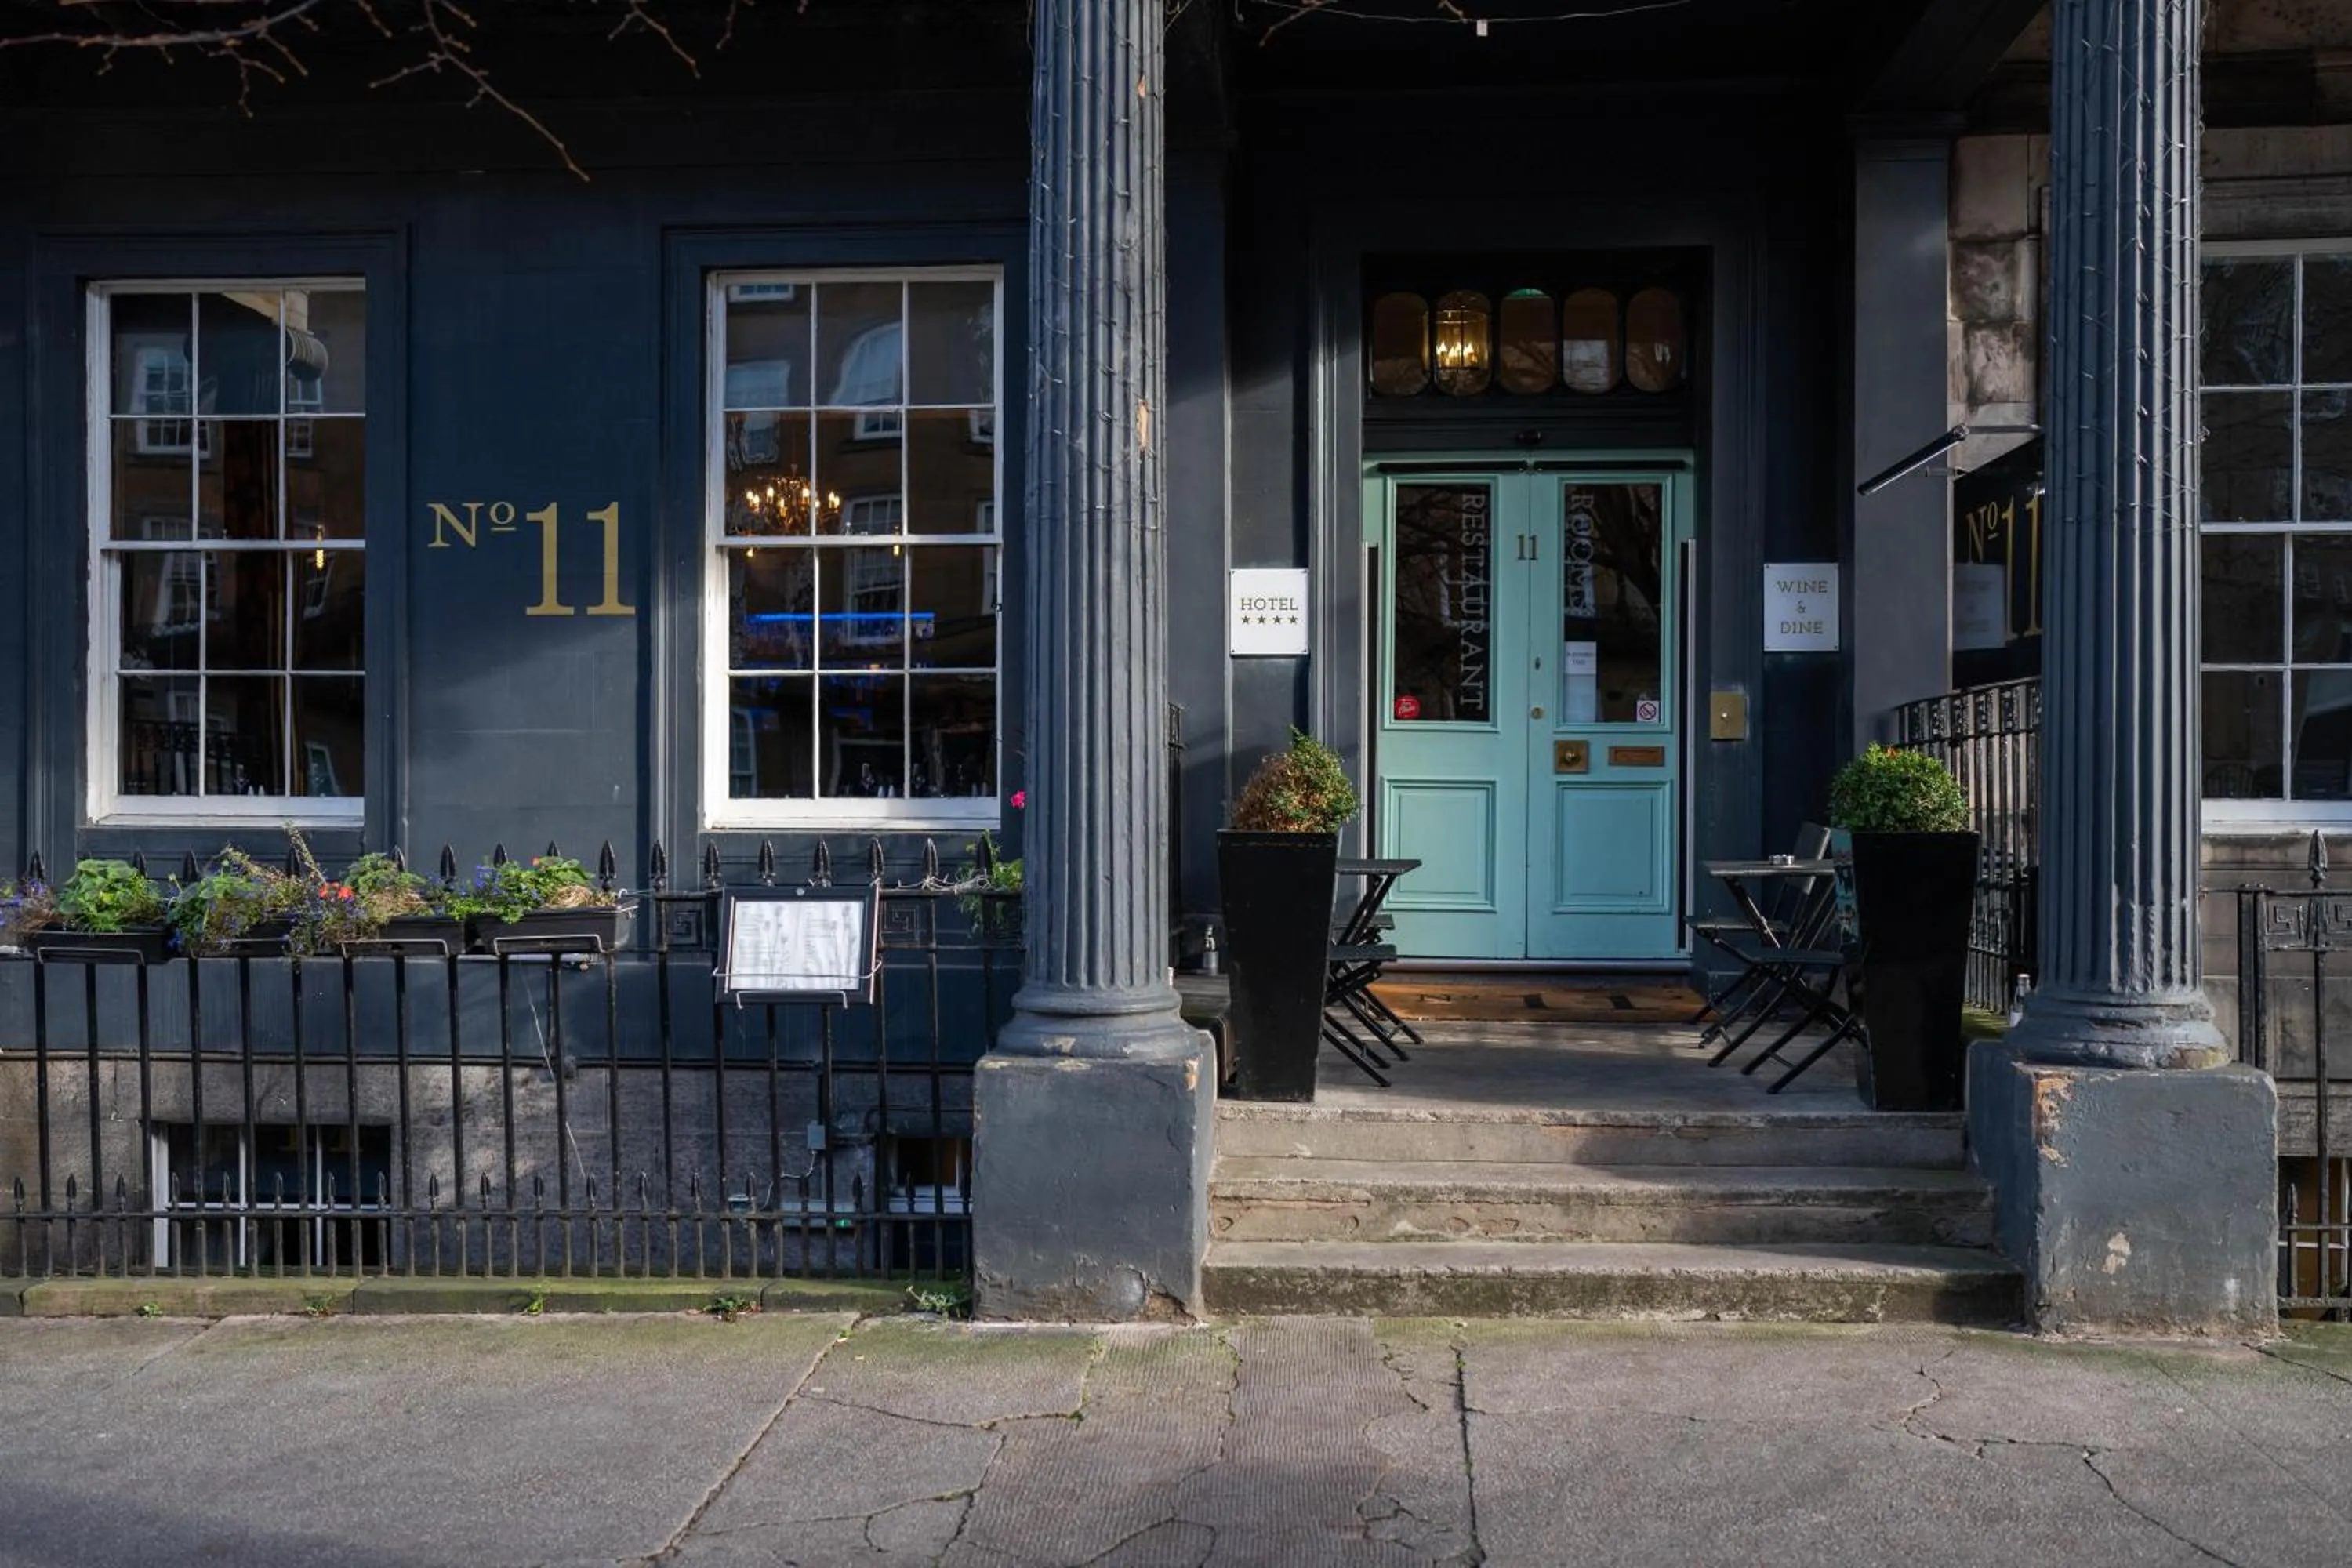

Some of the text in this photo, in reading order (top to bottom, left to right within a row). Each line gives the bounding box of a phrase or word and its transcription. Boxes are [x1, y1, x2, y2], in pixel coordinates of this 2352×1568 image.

[1517, 535, 1537, 561] 11
[1777, 580, 1828, 593] WINE
[1241, 597, 1299, 611] HOTEL
[1460, 494, 1485, 710] RESTAURANT
[1797, 600, 1806, 613] &
[1780, 621, 1823, 634] DINE
